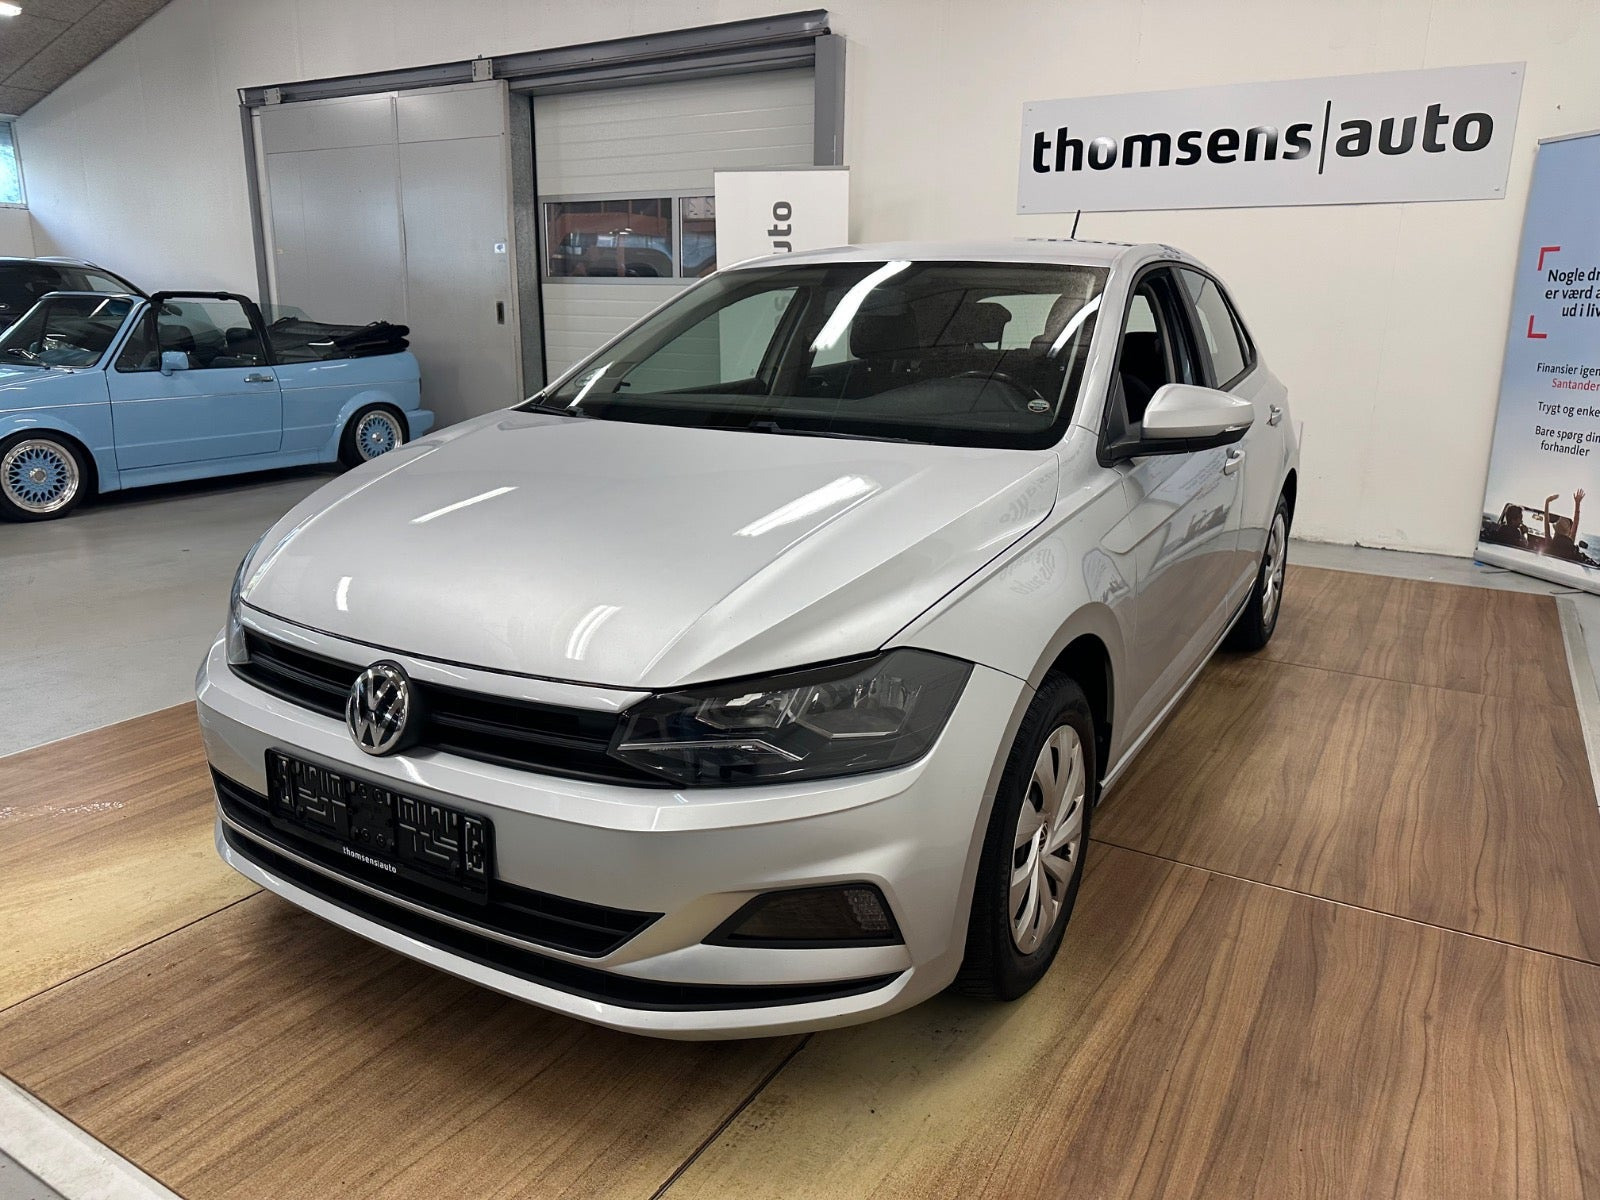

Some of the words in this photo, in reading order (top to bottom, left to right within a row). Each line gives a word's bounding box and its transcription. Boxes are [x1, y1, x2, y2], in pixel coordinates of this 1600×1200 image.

[1548, 268, 1585, 285] Nogle
[1545, 290, 1559, 299] er
[1562, 285, 1593, 299] værd
[1562, 303, 1577, 317] ud
[1580, 303, 1584, 317] i
[1536, 362, 1578, 375] Finansier
[1580, 365, 1600, 379] igen
[1551, 378, 1600, 391] Santander
[1538, 401, 1561, 416] Trygt
[1562, 405, 1575, 417] og
[1576, 405, 1600, 417] enke
[1535, 425, 1555, 437] Bare
[1556, 429, 1584, 444] spørg
[1540, 439, 1590, 456] forhandler
